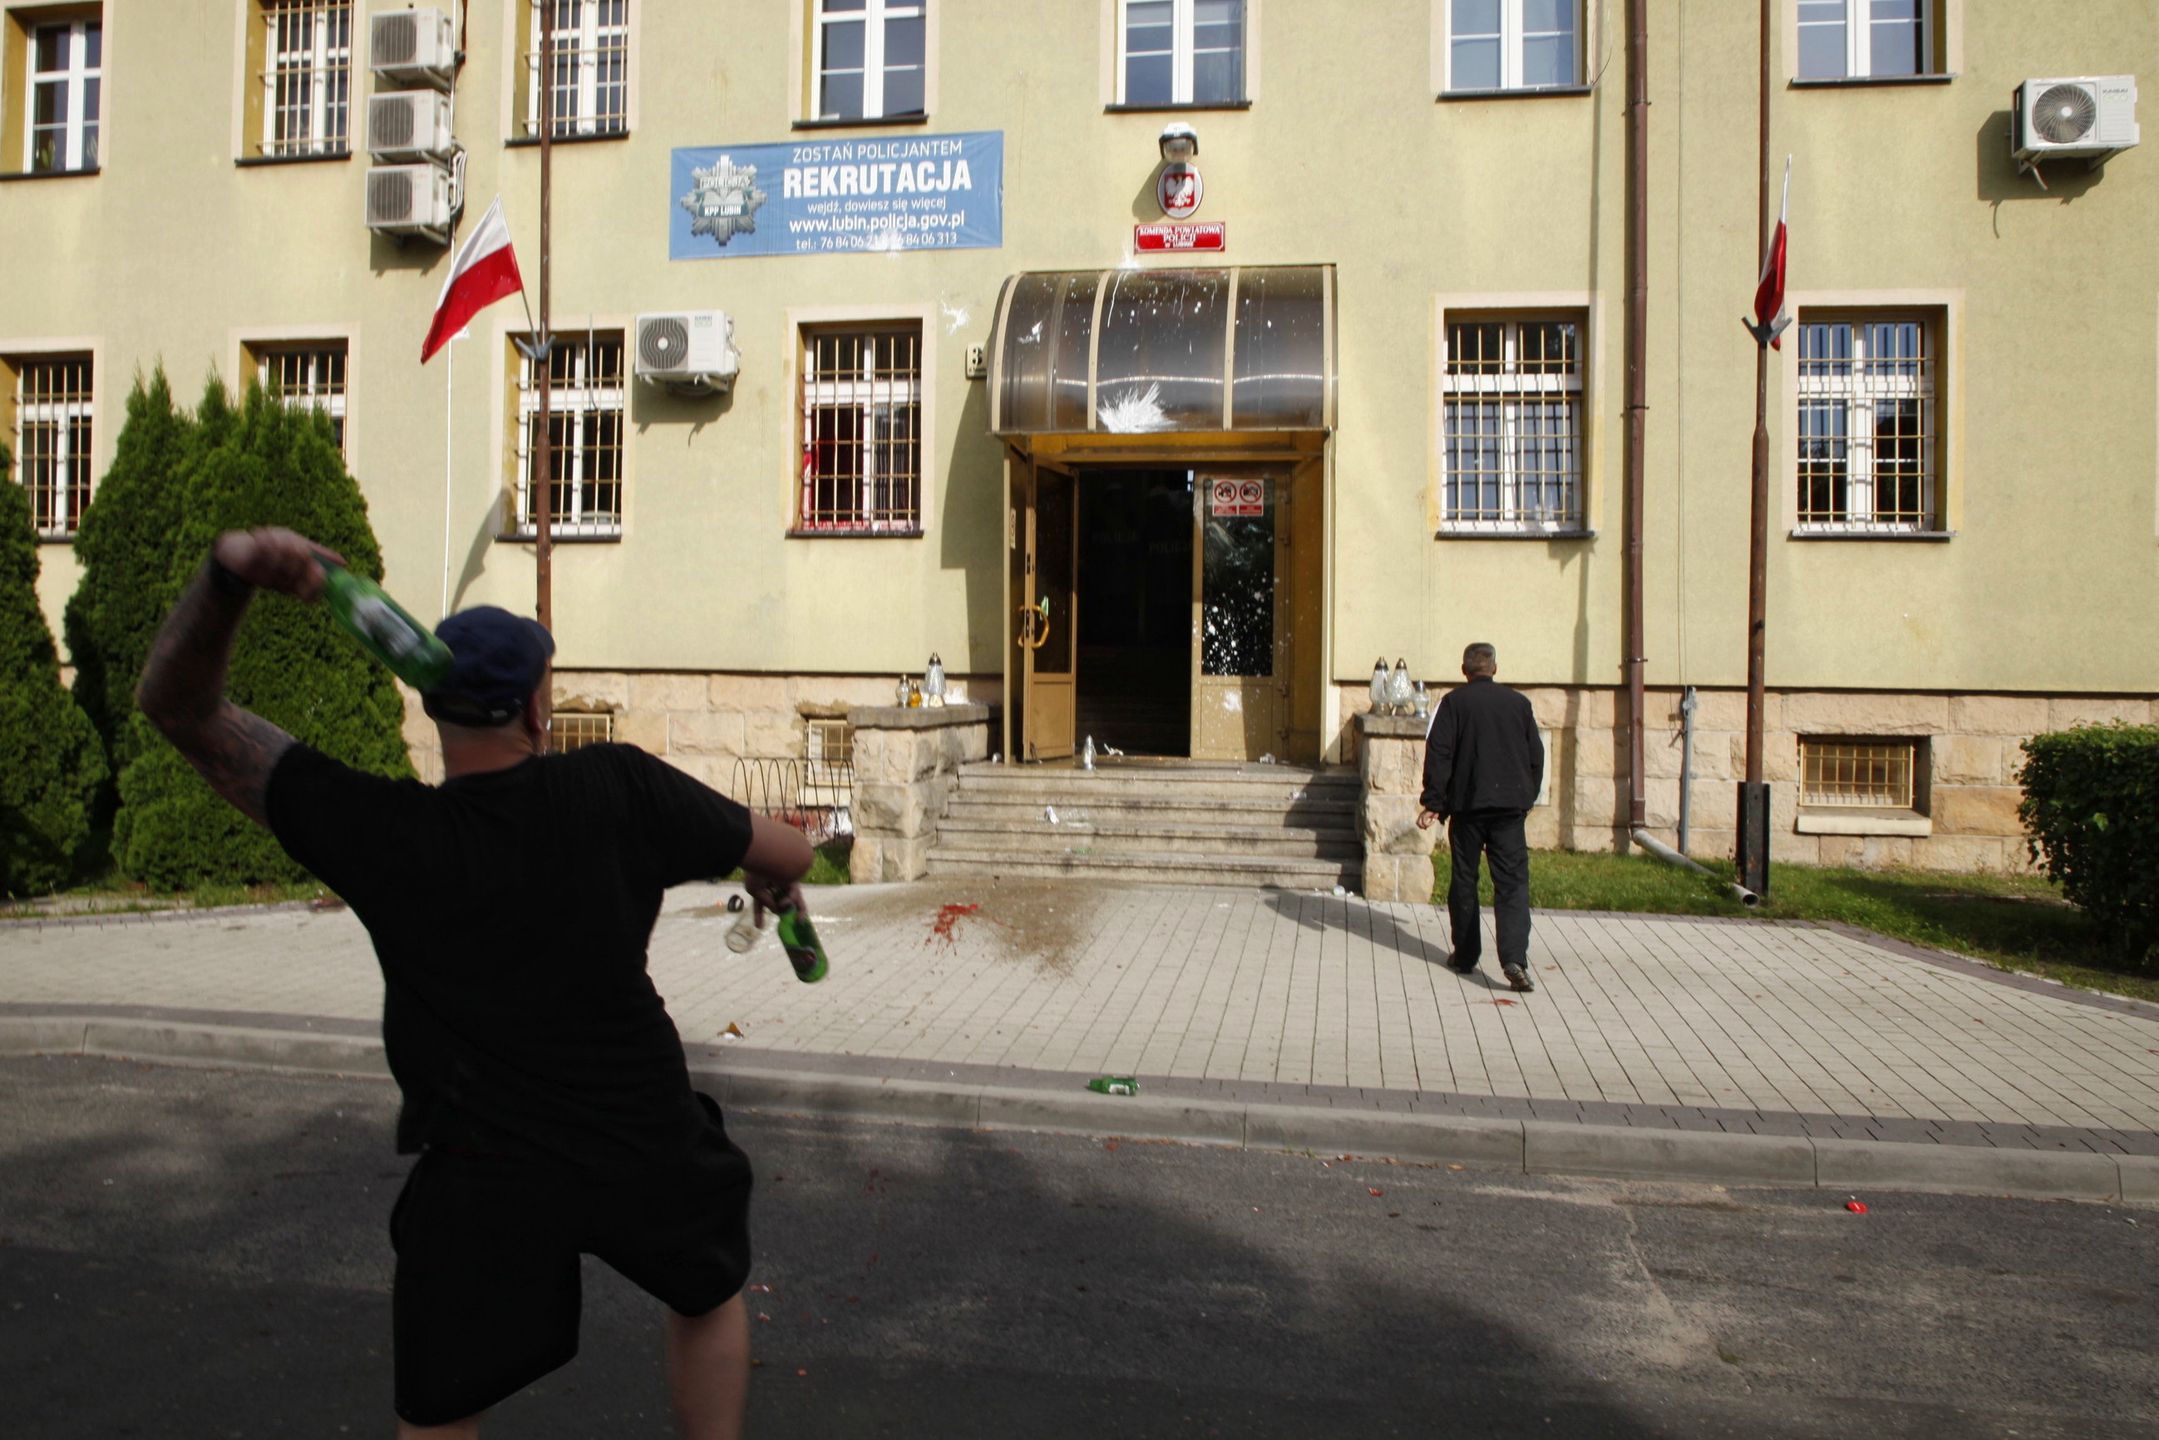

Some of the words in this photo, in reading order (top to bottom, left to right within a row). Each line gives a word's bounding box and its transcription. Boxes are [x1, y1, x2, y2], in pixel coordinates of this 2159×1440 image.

[792, 141, 852, 164] ZOSTAŃ
[857, 139, 963, 160] POLICJANTEM
[783, 159, 972, 199] REKRUTACJA
[704, 205, 720, 217] KPP
[844, 199, 889, 213] dowiesz
[892, 198, 907, 211] się
[911, 195, 946, 211] więcej
[789, 209, 966, 234] www.lubin.policja.gov.pl
[1140, 226, 1172, 235] KOMENDA
[1175, 225, 1221, 234] POWIATOWA
[796, 237, 817, 250] tel.:
[820, 236, 833, 250] 76
[835, 235, 849, 248] 84
[851, 235, 864, 248] 06
[906, 232, 919, 245] 84
[921, 231, 935, 244] 06
[938, 231, 958, 245] 313
[1163, 233, 1196, 243] POLICJI
